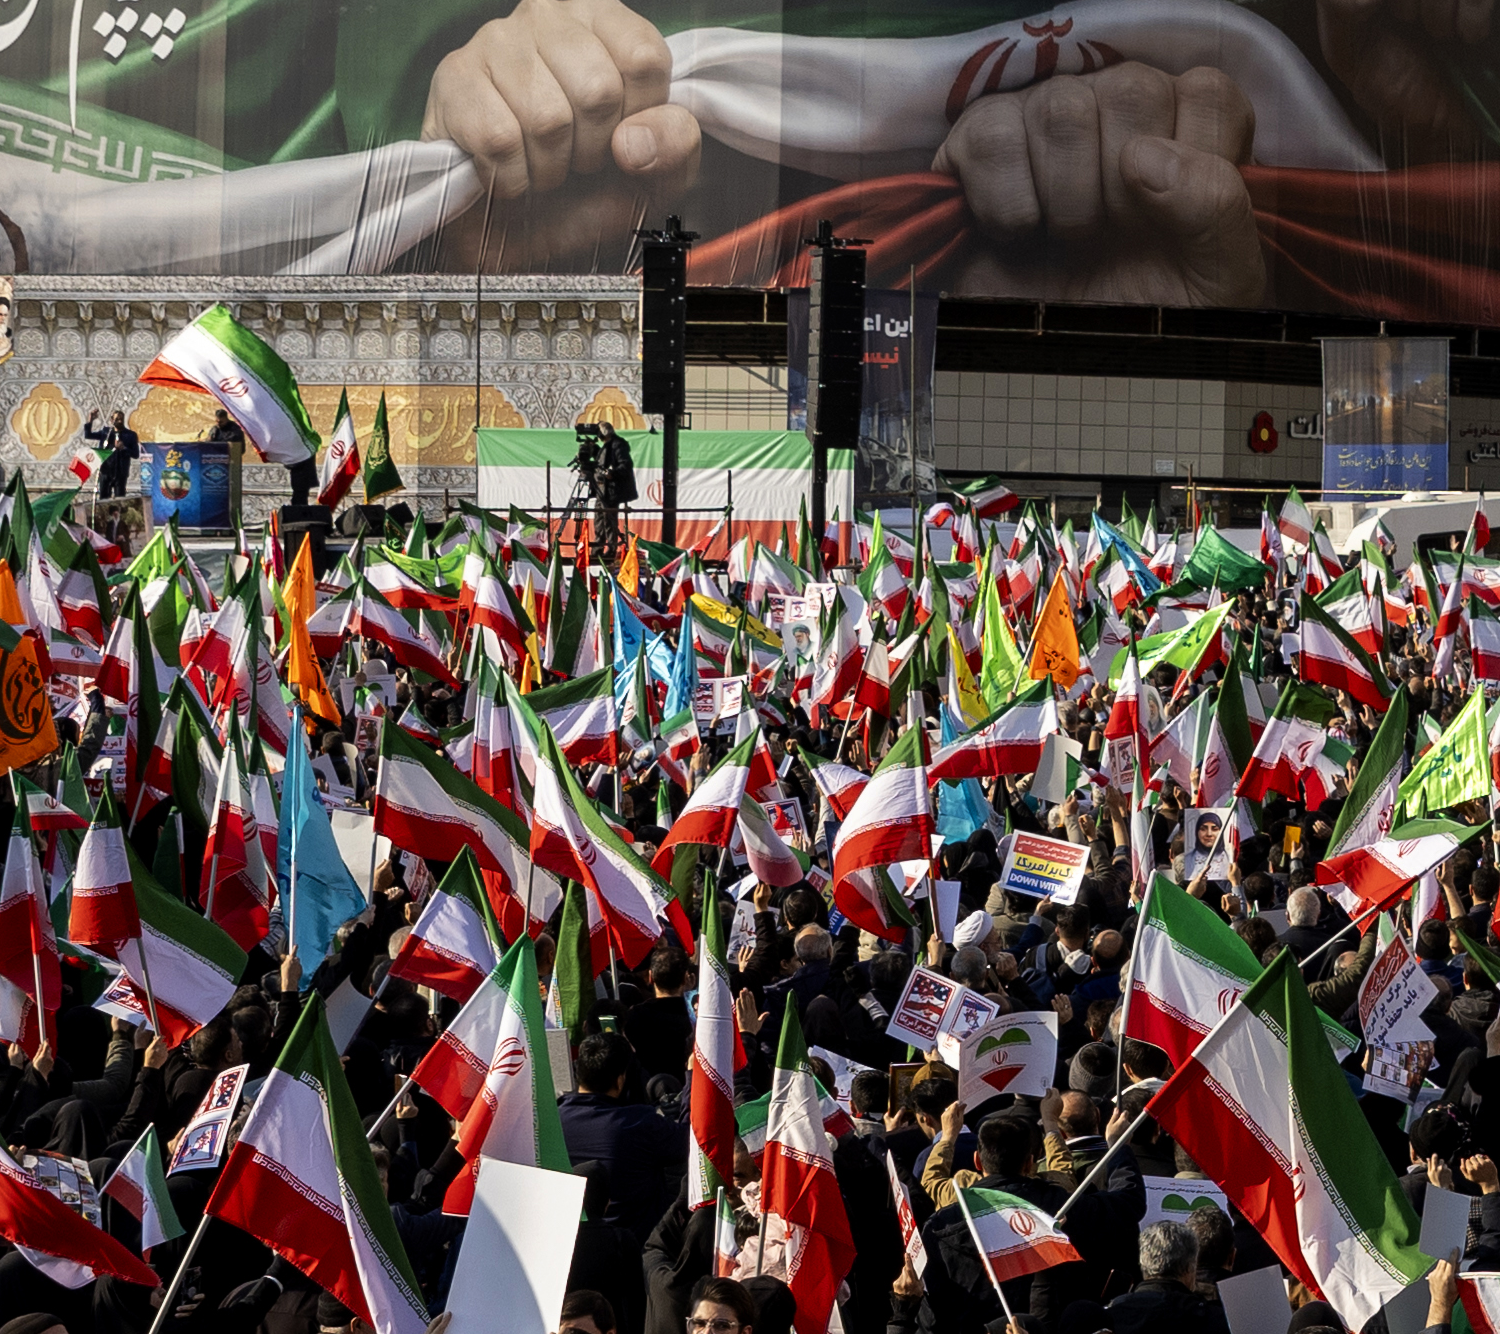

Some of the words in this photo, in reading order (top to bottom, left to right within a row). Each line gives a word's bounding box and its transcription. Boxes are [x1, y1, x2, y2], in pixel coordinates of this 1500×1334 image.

[885, 314, 914, 338] این
[863, 346, 899, 369] نیس
[1288, 412, 1324, 440] لت
[1009, 872, 1040, 887] DOWN
[1400, 960, 1417, 988] شعار
[1385, 982, 1402, 1004] مرگ
